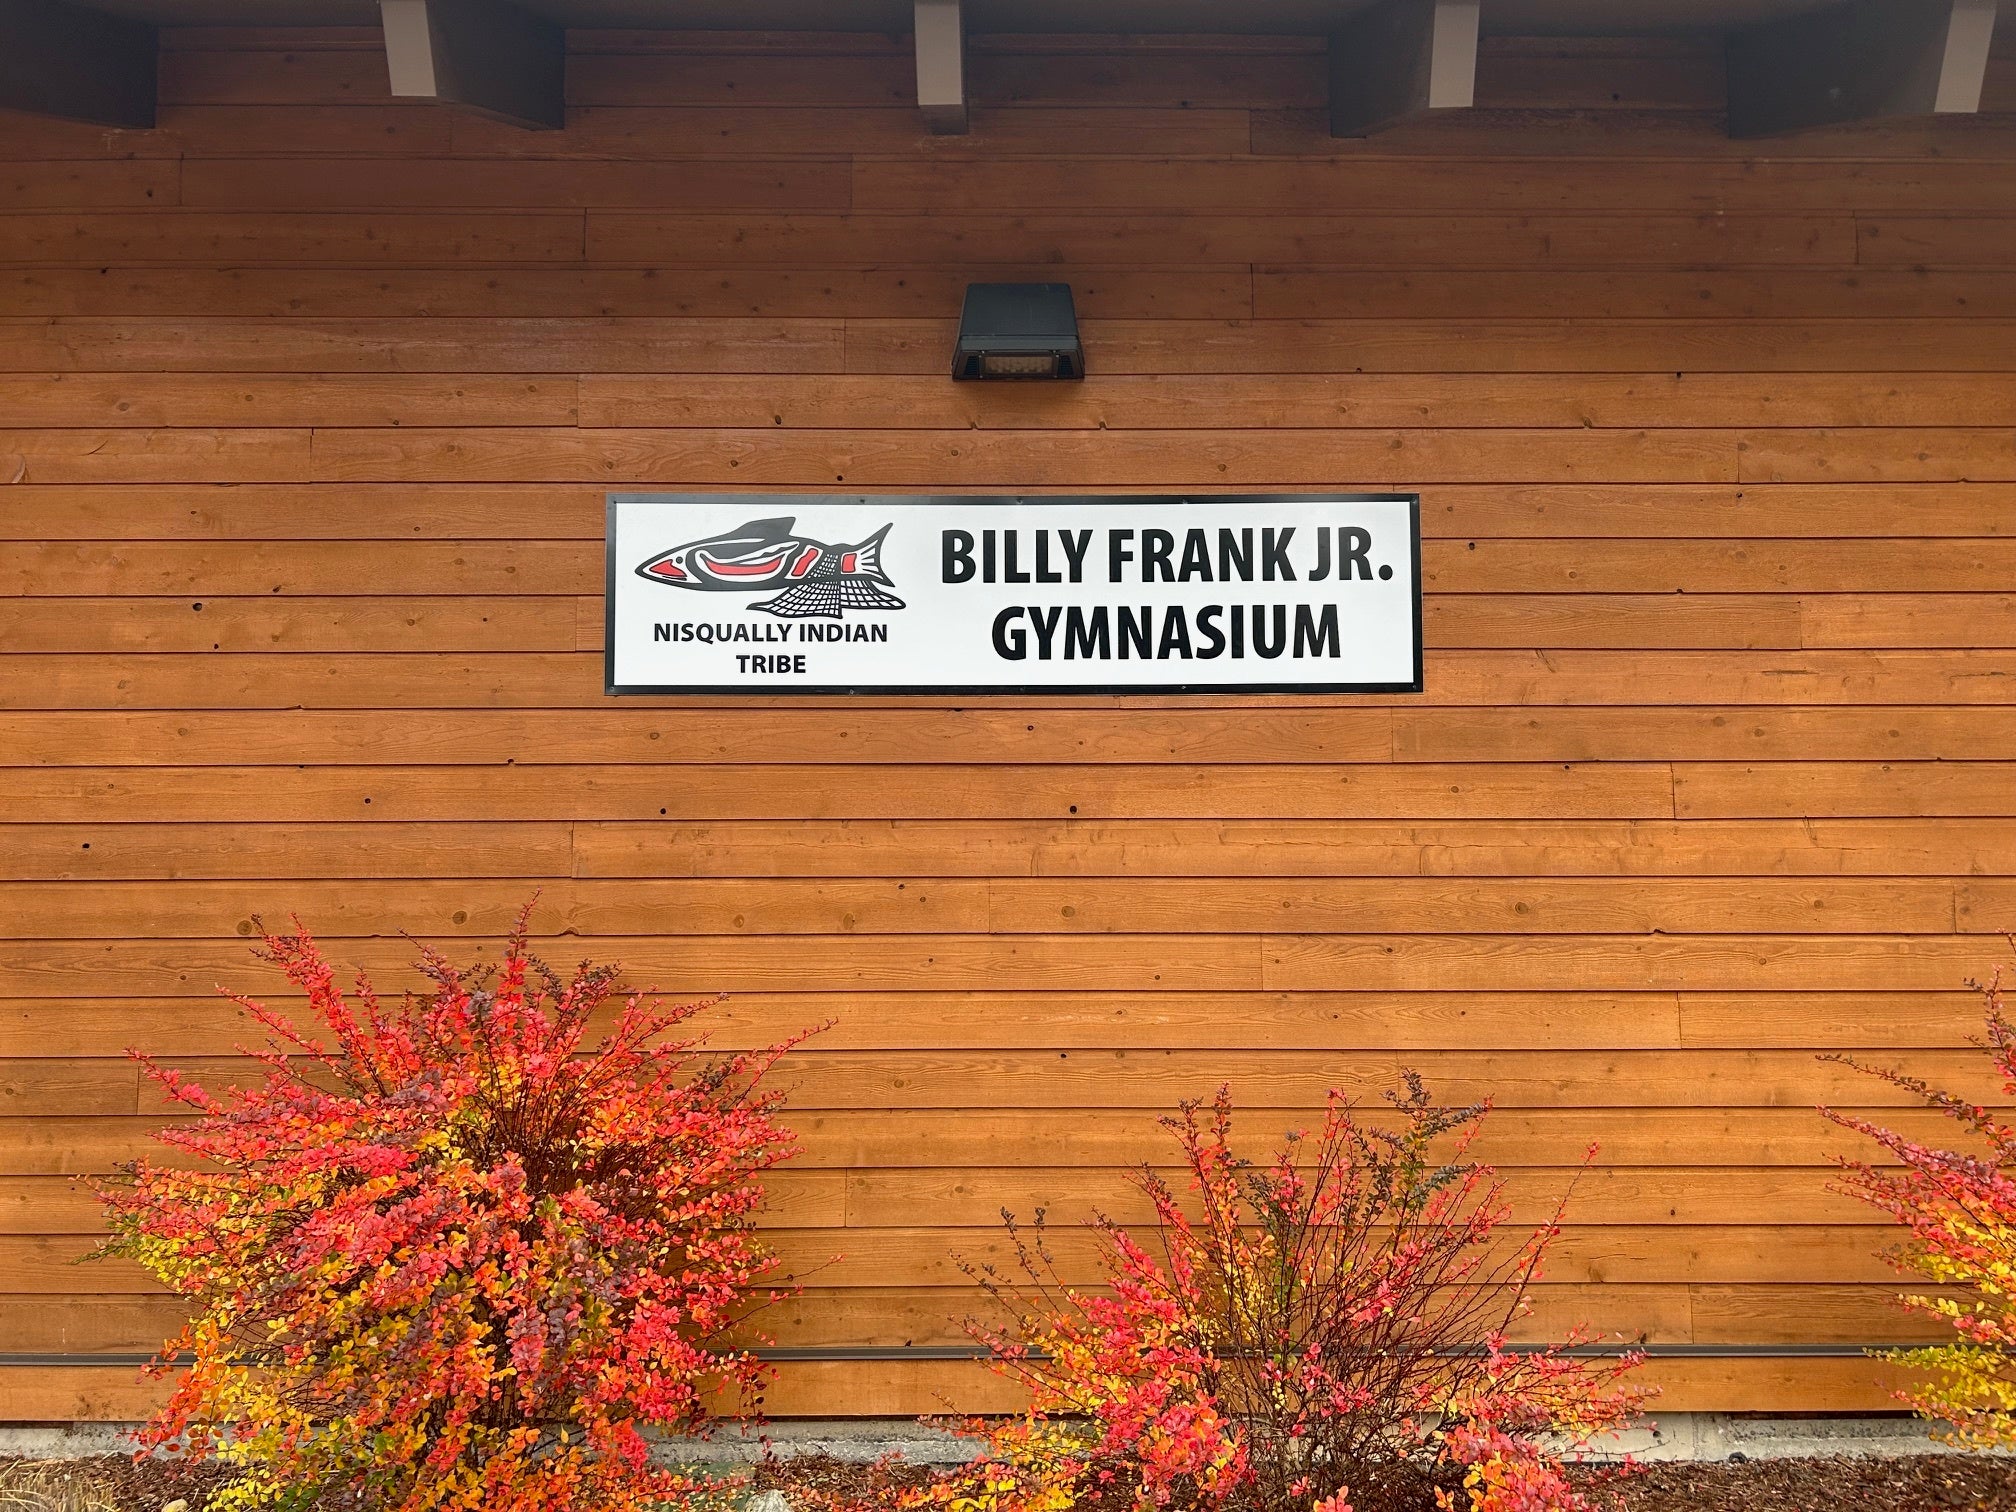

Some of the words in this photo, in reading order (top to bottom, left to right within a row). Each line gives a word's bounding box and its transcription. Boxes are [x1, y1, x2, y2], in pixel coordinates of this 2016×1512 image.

[943, 529, 1093, 584] BILLY
[1109, 527, 1298, 583] FRANK
[1308, 526, 1394, 582] JR.
[654, 623, 793, 645] NISQUALLY
[799, 623, 888, 643] INDIAN
[991, 604, 1341, 661] GYMNASIUM
[735, 654, 806, 674] TRIBE
